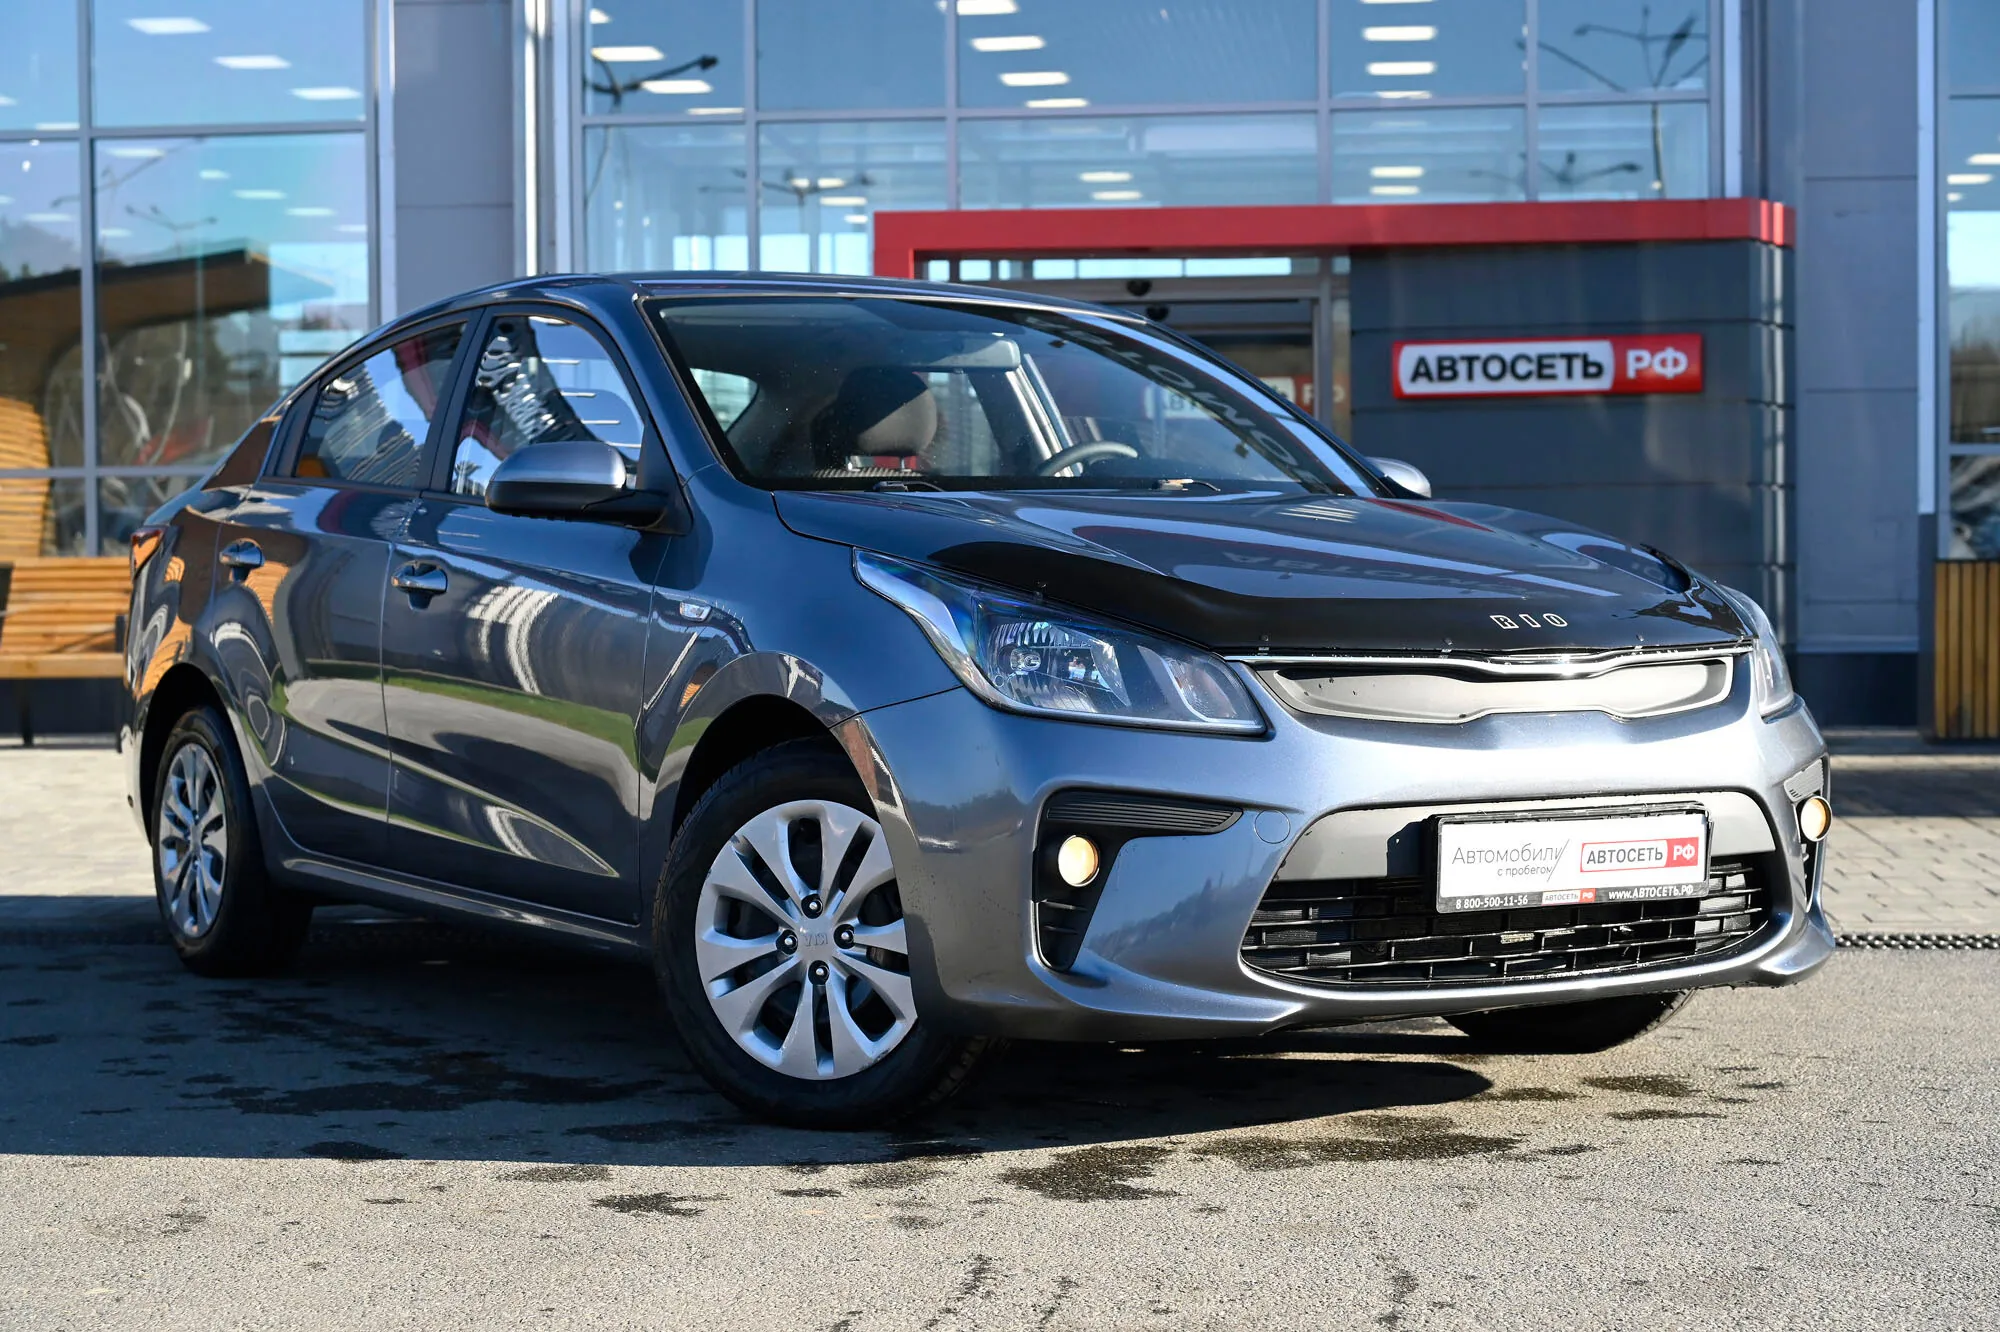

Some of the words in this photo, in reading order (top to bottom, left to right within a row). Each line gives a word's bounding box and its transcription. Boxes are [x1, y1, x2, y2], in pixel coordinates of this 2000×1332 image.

[1410, 352, 1604, 383] АВТОСЕТЬ
[1626, 346, 1688, 379] РФ
[1489, 613, 1568, 629] RIO
[1586, 847, 1663, 865] АВТОСЕТЬ
[1673, 844, 1696, 861] РФ
[1545, 893, 1579, 901] АВТОСЕТЬ
[1582, 891, 1594, 899] РФ
[1608, 884, 1694, 900] www.АВТОСЕТЬ.РФ
[1455, 899, 1461, 910] 8
[1463, 895, 1529, 908] 800-500-11-56
